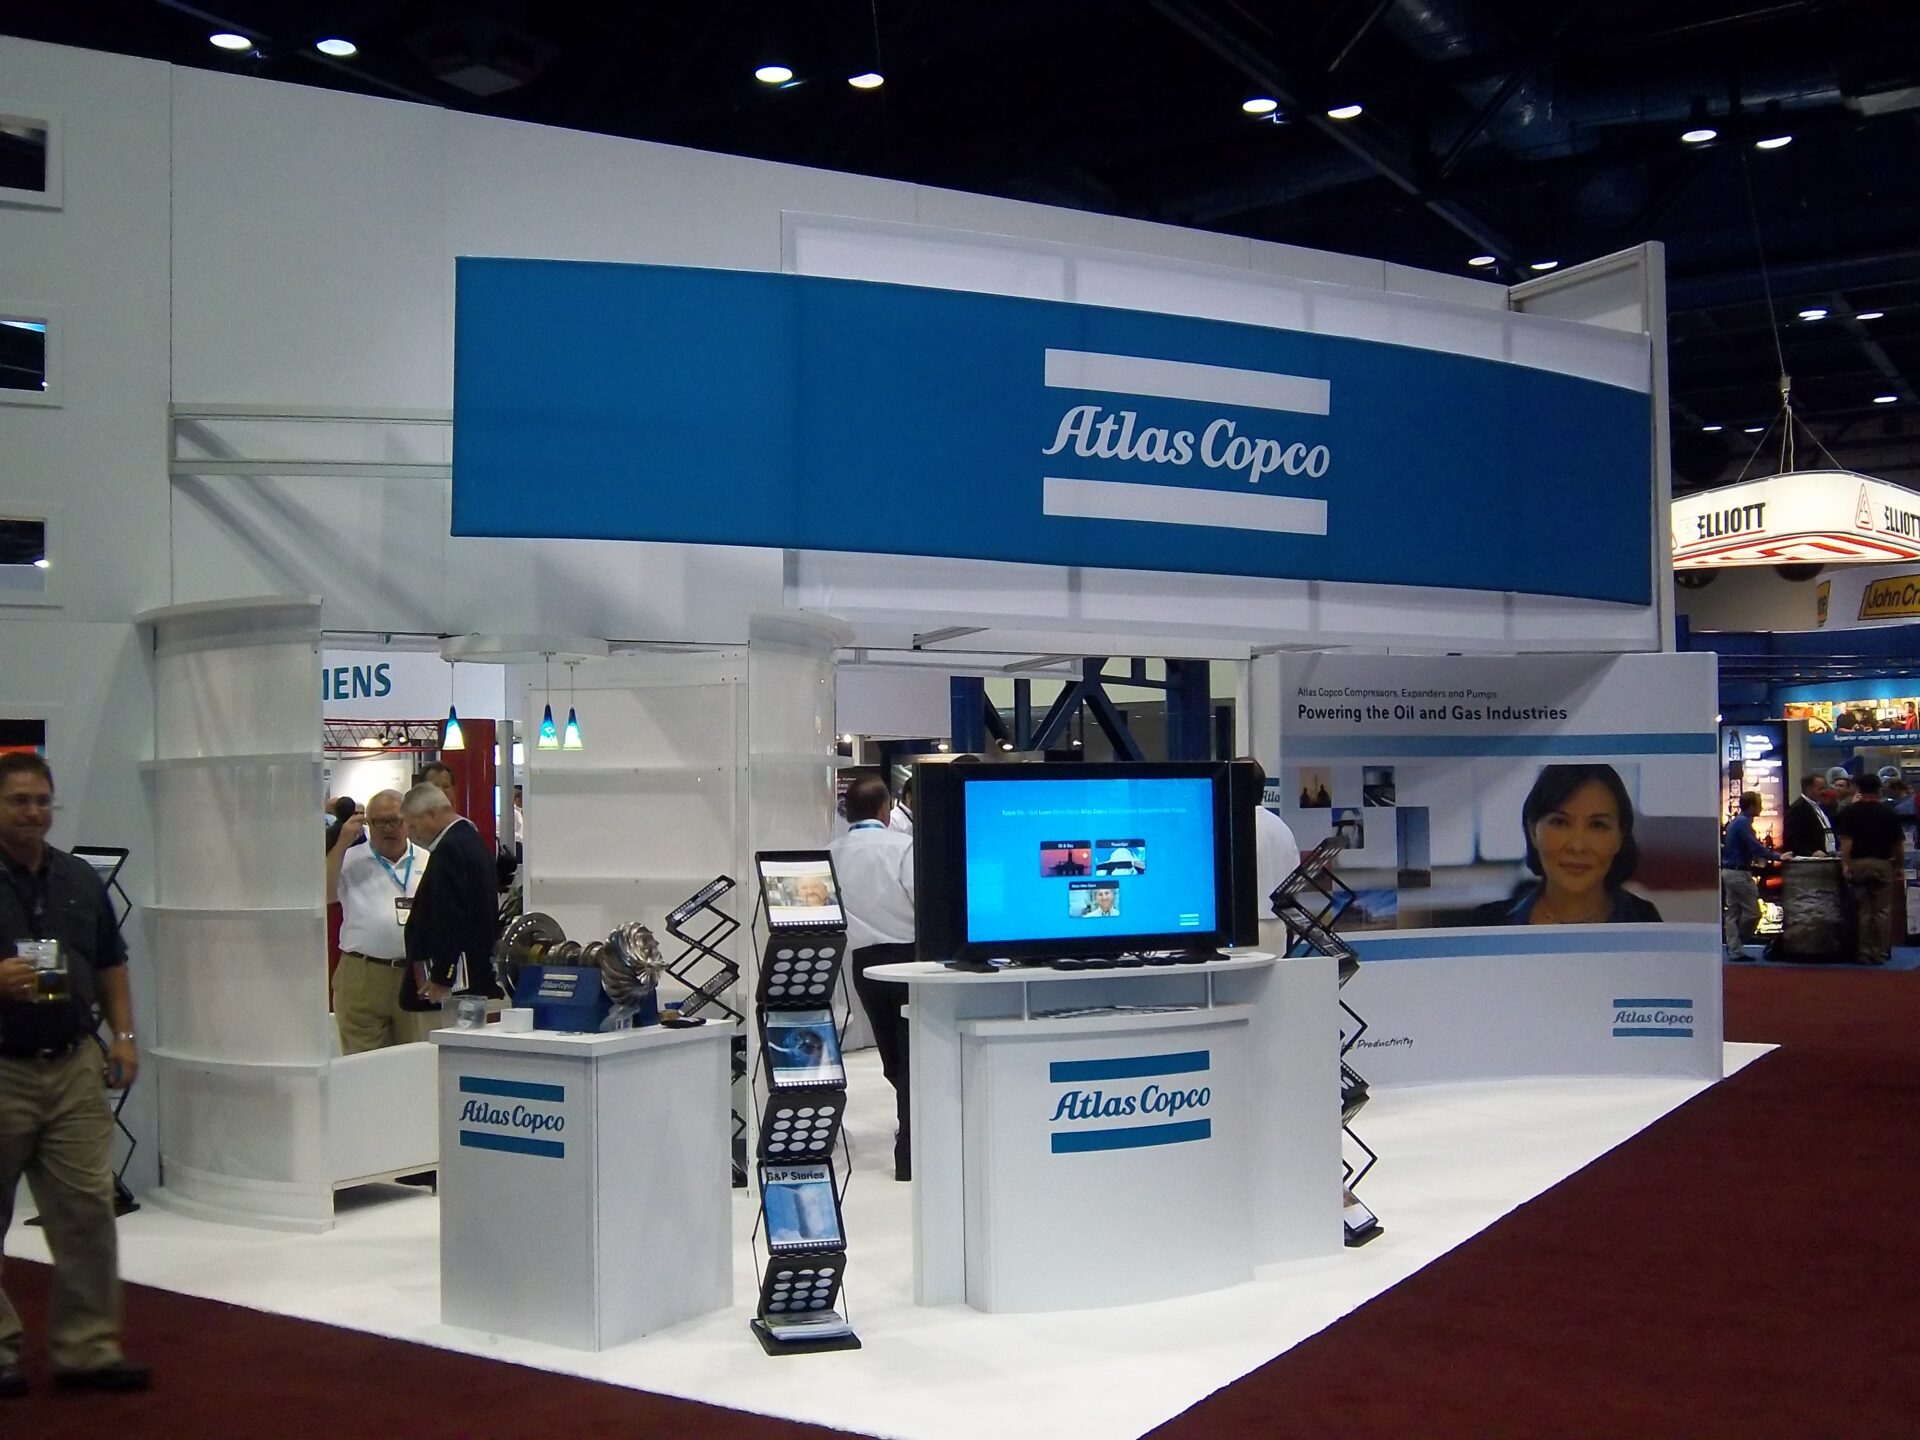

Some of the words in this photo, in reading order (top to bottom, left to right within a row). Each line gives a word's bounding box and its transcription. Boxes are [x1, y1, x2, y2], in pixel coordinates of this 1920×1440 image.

[1042, 405, 1195, 465] Atlas
[1200, 419, 1330, 483] Copco
[1697, 502, 1766, 539] ELLIOTT
[1868, 586, 1901, 608] John
[1298, 687, 1317, 697] Atlas
[1318, 687, 1343, 699] Copco
[1344, 687, 1399, 700] Compressors,
[1401, 688, 1447, 700] Expanders
[1448, 690, 1465, 699] and
[1466, 689, 1498, 701] Pumps
[1298, 704, 1362, 723] Powering
[1366, 705, 1390, 720] the
[1394, 705, 1414, 720] Oil
[1419, 706, 1447, 720] and
[1452, 705, 1482, 720] Gas
[1486, 706, 1568, 720] Industries
[1613, 1010, 1653, 1024] Atlas
[1653, 1011, 1694, 1025] Copco
[1357, 1036, 1414, 1050] Productivity
[1049, 1091, 1137, 1121] Atlas
[1140, 1085, 1211, 1117] Copco
[459, 1100, 510, 1126] Atlas
[512, 1105, 565, 1134] Copco
[790, 1171, 825, 1180] Stories
